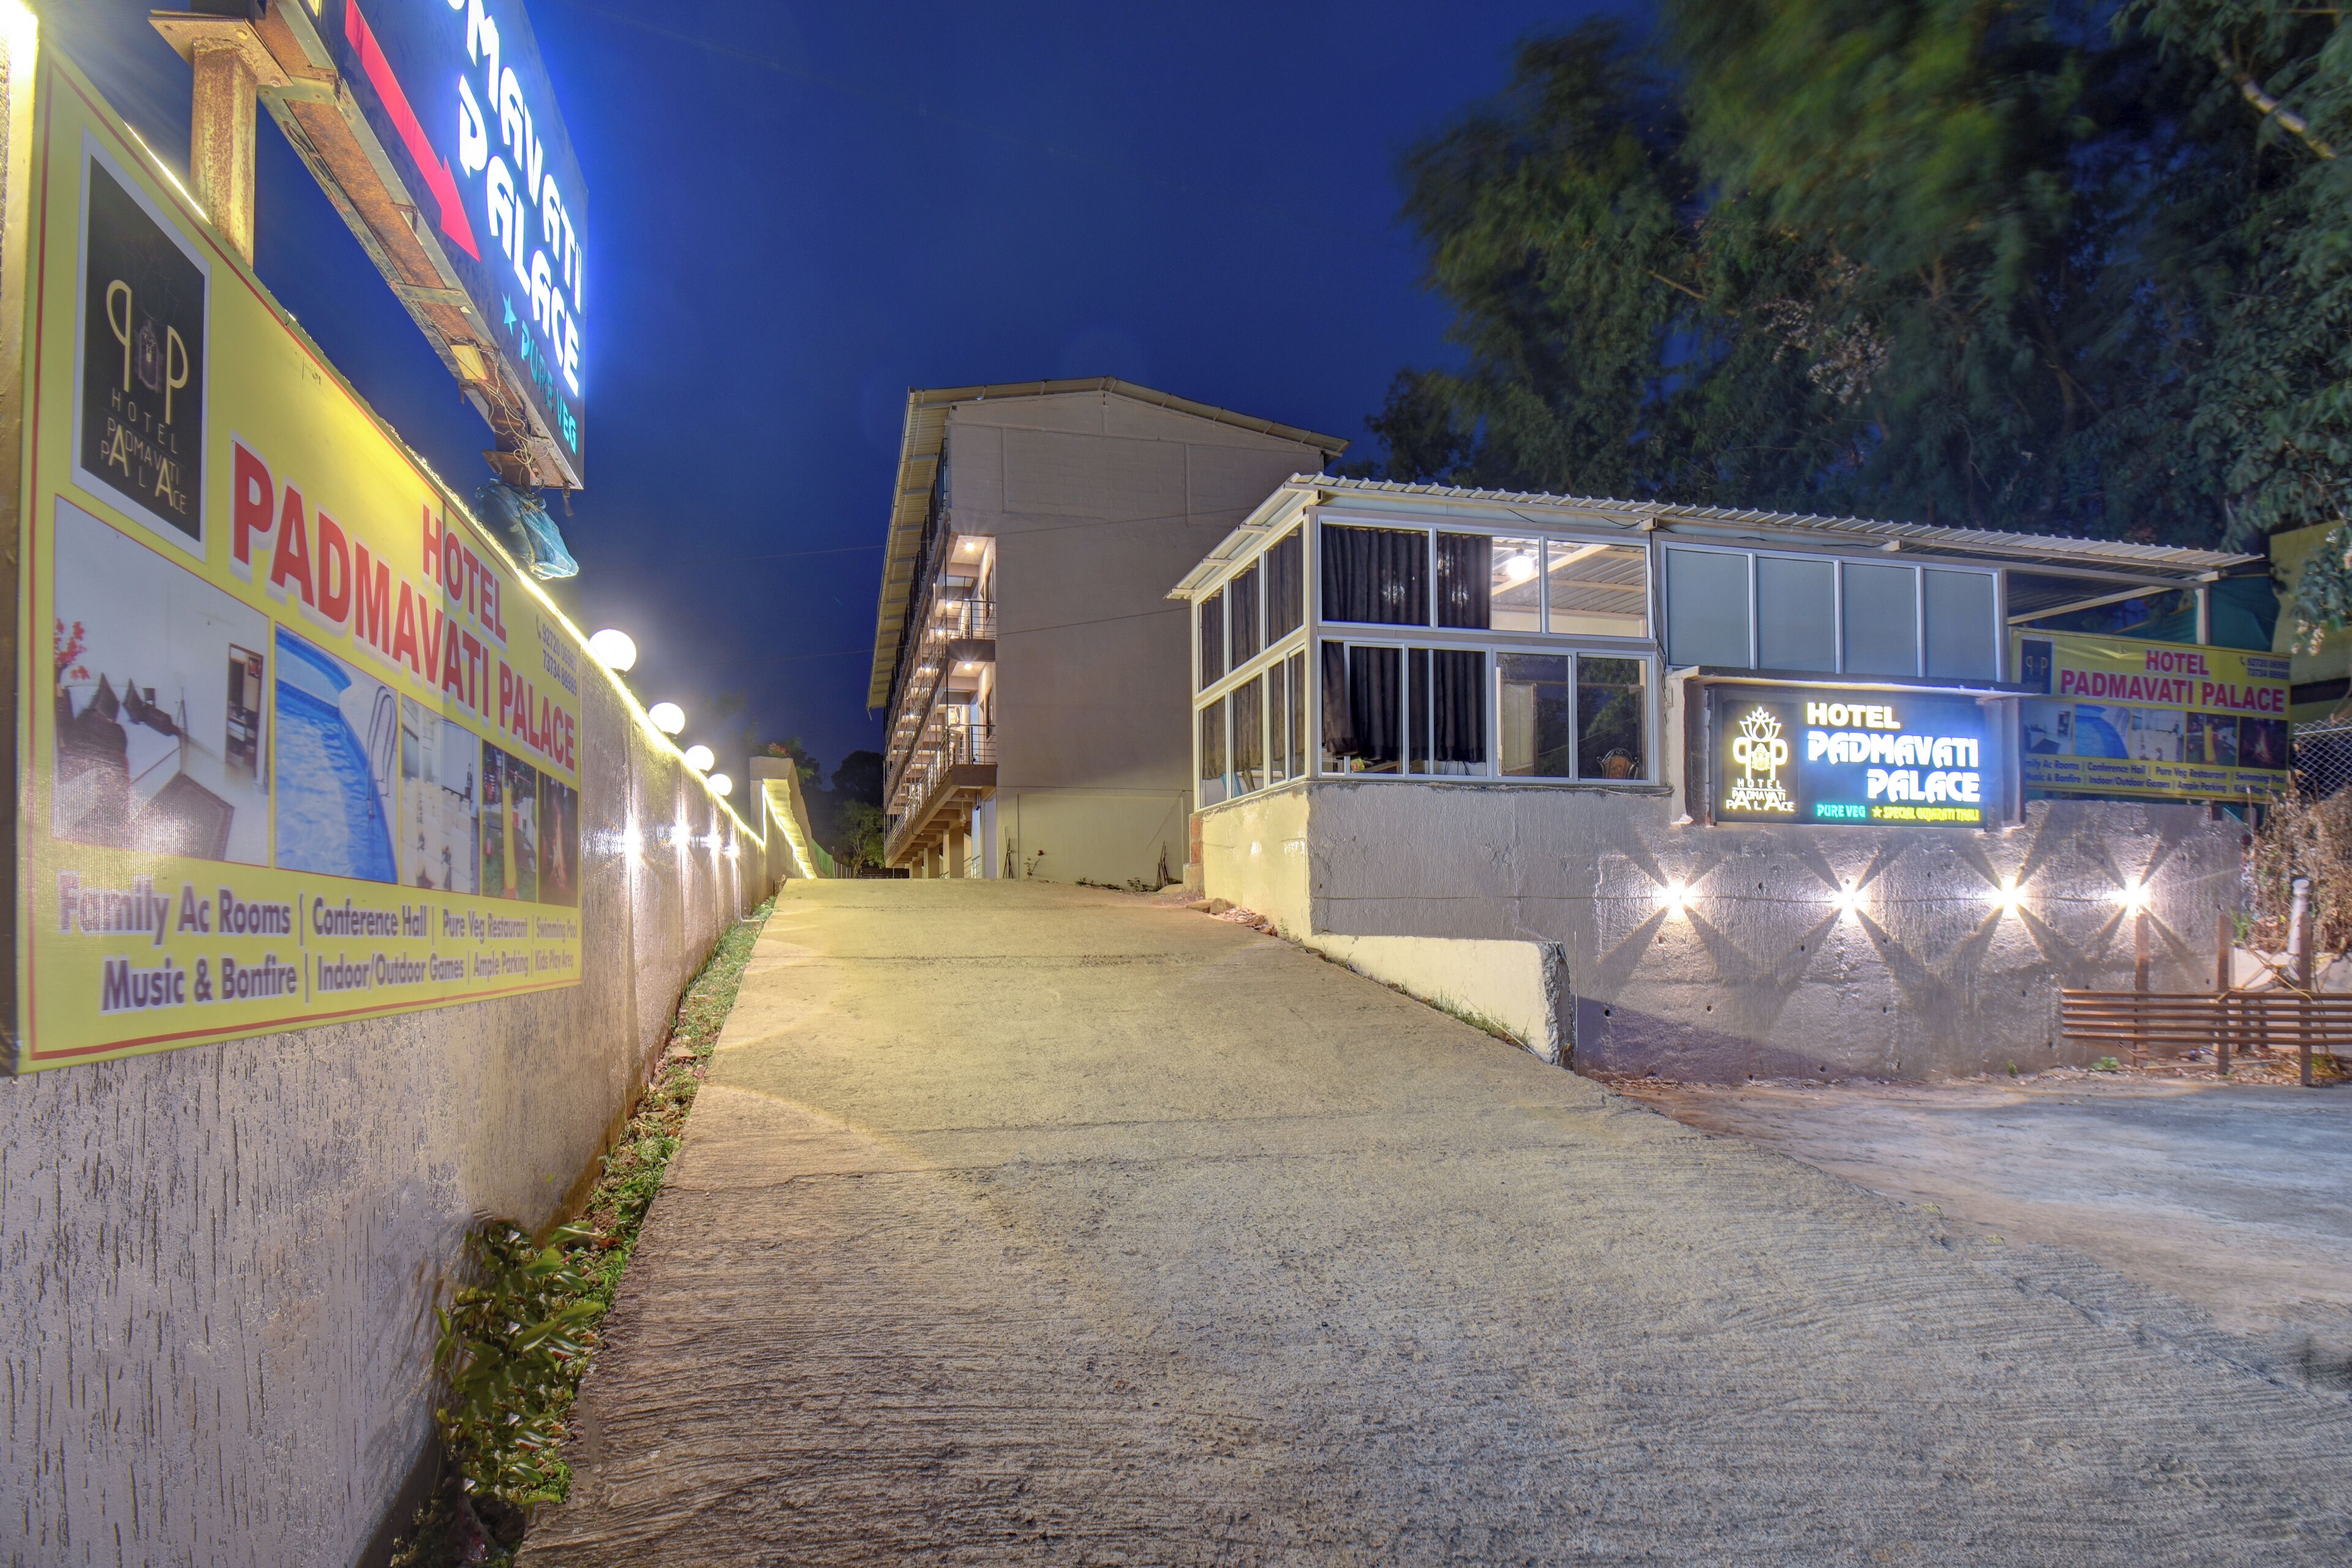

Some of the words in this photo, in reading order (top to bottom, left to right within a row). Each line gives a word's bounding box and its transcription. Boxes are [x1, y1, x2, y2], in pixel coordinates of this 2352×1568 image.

[448, 0, 581, 314] MAVATI
[459, 73, 579, 397] PALACE
[521, 318, 554, 414] PURE
[556, 387, 578, 455] VEG
[112, 387, 178, 454] HOTEL
[108, 417, 179, 486] PADMAVATI
[423, 503, 507, 644] HOTEL
[233, 441, 489, 718] PADMAVATI
[499, 660, 575, 772] PALACE
[543, 622, 560, 657] 92720
[543, 648, 560, 682] 73734
[2147, 649, 2210, 676] HOTEL
[2060, 669, 2193, 704] PADMAVATI
[2201, 682, 2285, 712] PALACE
[1807, 702, 1901, 729] HOTEL
[1807, 730, 1979, 768] PADMAVATI
[1736, 778, 1782, 790] HOTEL
[1866, 769, 1980, 803] PALACE
[2054, 760, 2079, 770] Rooms
[2087, 762, 2129, 773] Conference
[2130, 764, 2146, 774] Hall
[2155, 766, 2172, 776] Pure
[2174, 767, 2187, 778] Veg
[2055, 773, 2082, 783] Bonfire
[2089, 775, 2144, 786] Indoor/Outdoor
[2147, 778, 2171, 789] Games
[2178, 780, 2199, 791] Ample
[2201, 782, 2227, 794] Parking
[1732, 790, 1786, 802] PADMAVATI
[1817, 804, 1844, 818] PURE
[1845, 805, 1866, 818] VEG
[1883, 806, 1916, 820] SPECIAL
[1916, 807, 1955, 821] GUJARATI
[1956, 808, 1980, 821] THALI
[59, 872, 171, 946] Family
[178, 885, 210, 933] Ac
[219, 889, 291, 935] Rooms
[312, 897, 398, 936] Conference
[402, 905, 427, 937] Hall
[443, 909, 466, 938] Pure
[467, 911, 484, 944] Veg
[488, 912, 527, 939] Restaurant
[537, 916, 565, 944] Swimming
[567, 918, 578, 939] Pool
[102, 956, 185, 1011] Music
[194, 958, 213, 1003] &
[221, 953, 296, 1000] Bonfire
[317, 951, 426, 991] Indoor/Outdoor
[429, 952, 464, 981] Games
[473, 950, 500, 983] Ample
[502, 949, 529, 978] Parking
[535, 948, 548, 971] Kids
[549, 948, 560, 974] Play
[562, 949, 574, 970] Area
